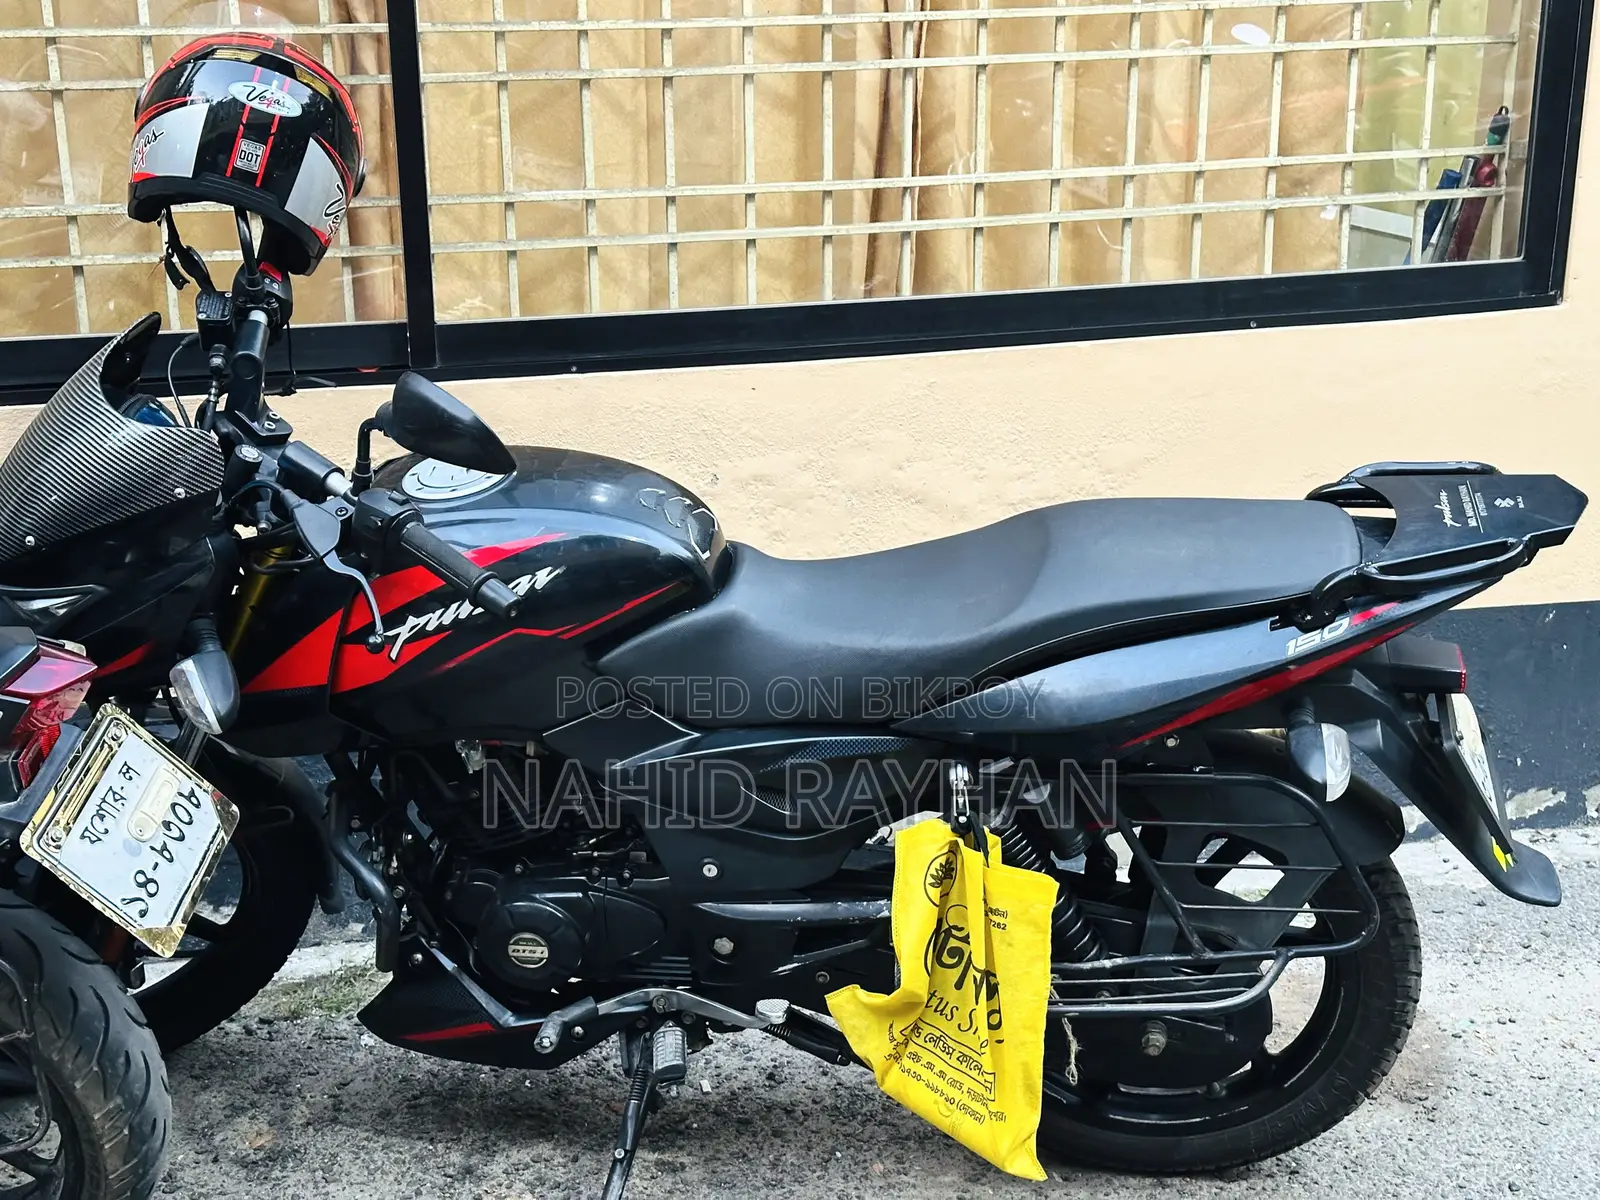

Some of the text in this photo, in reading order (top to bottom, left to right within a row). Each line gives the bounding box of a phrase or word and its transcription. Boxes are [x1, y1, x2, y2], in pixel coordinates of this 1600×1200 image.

[243, 84, 290, 109] Vegas
[133, 128, 165, 172] egas
[239, 149, 261, 165] DOT
[1286, 616, 1350, 656] 150
[924, 989, 959, 1021] tus
[924, 1032, 956, 1060] লেডিস
